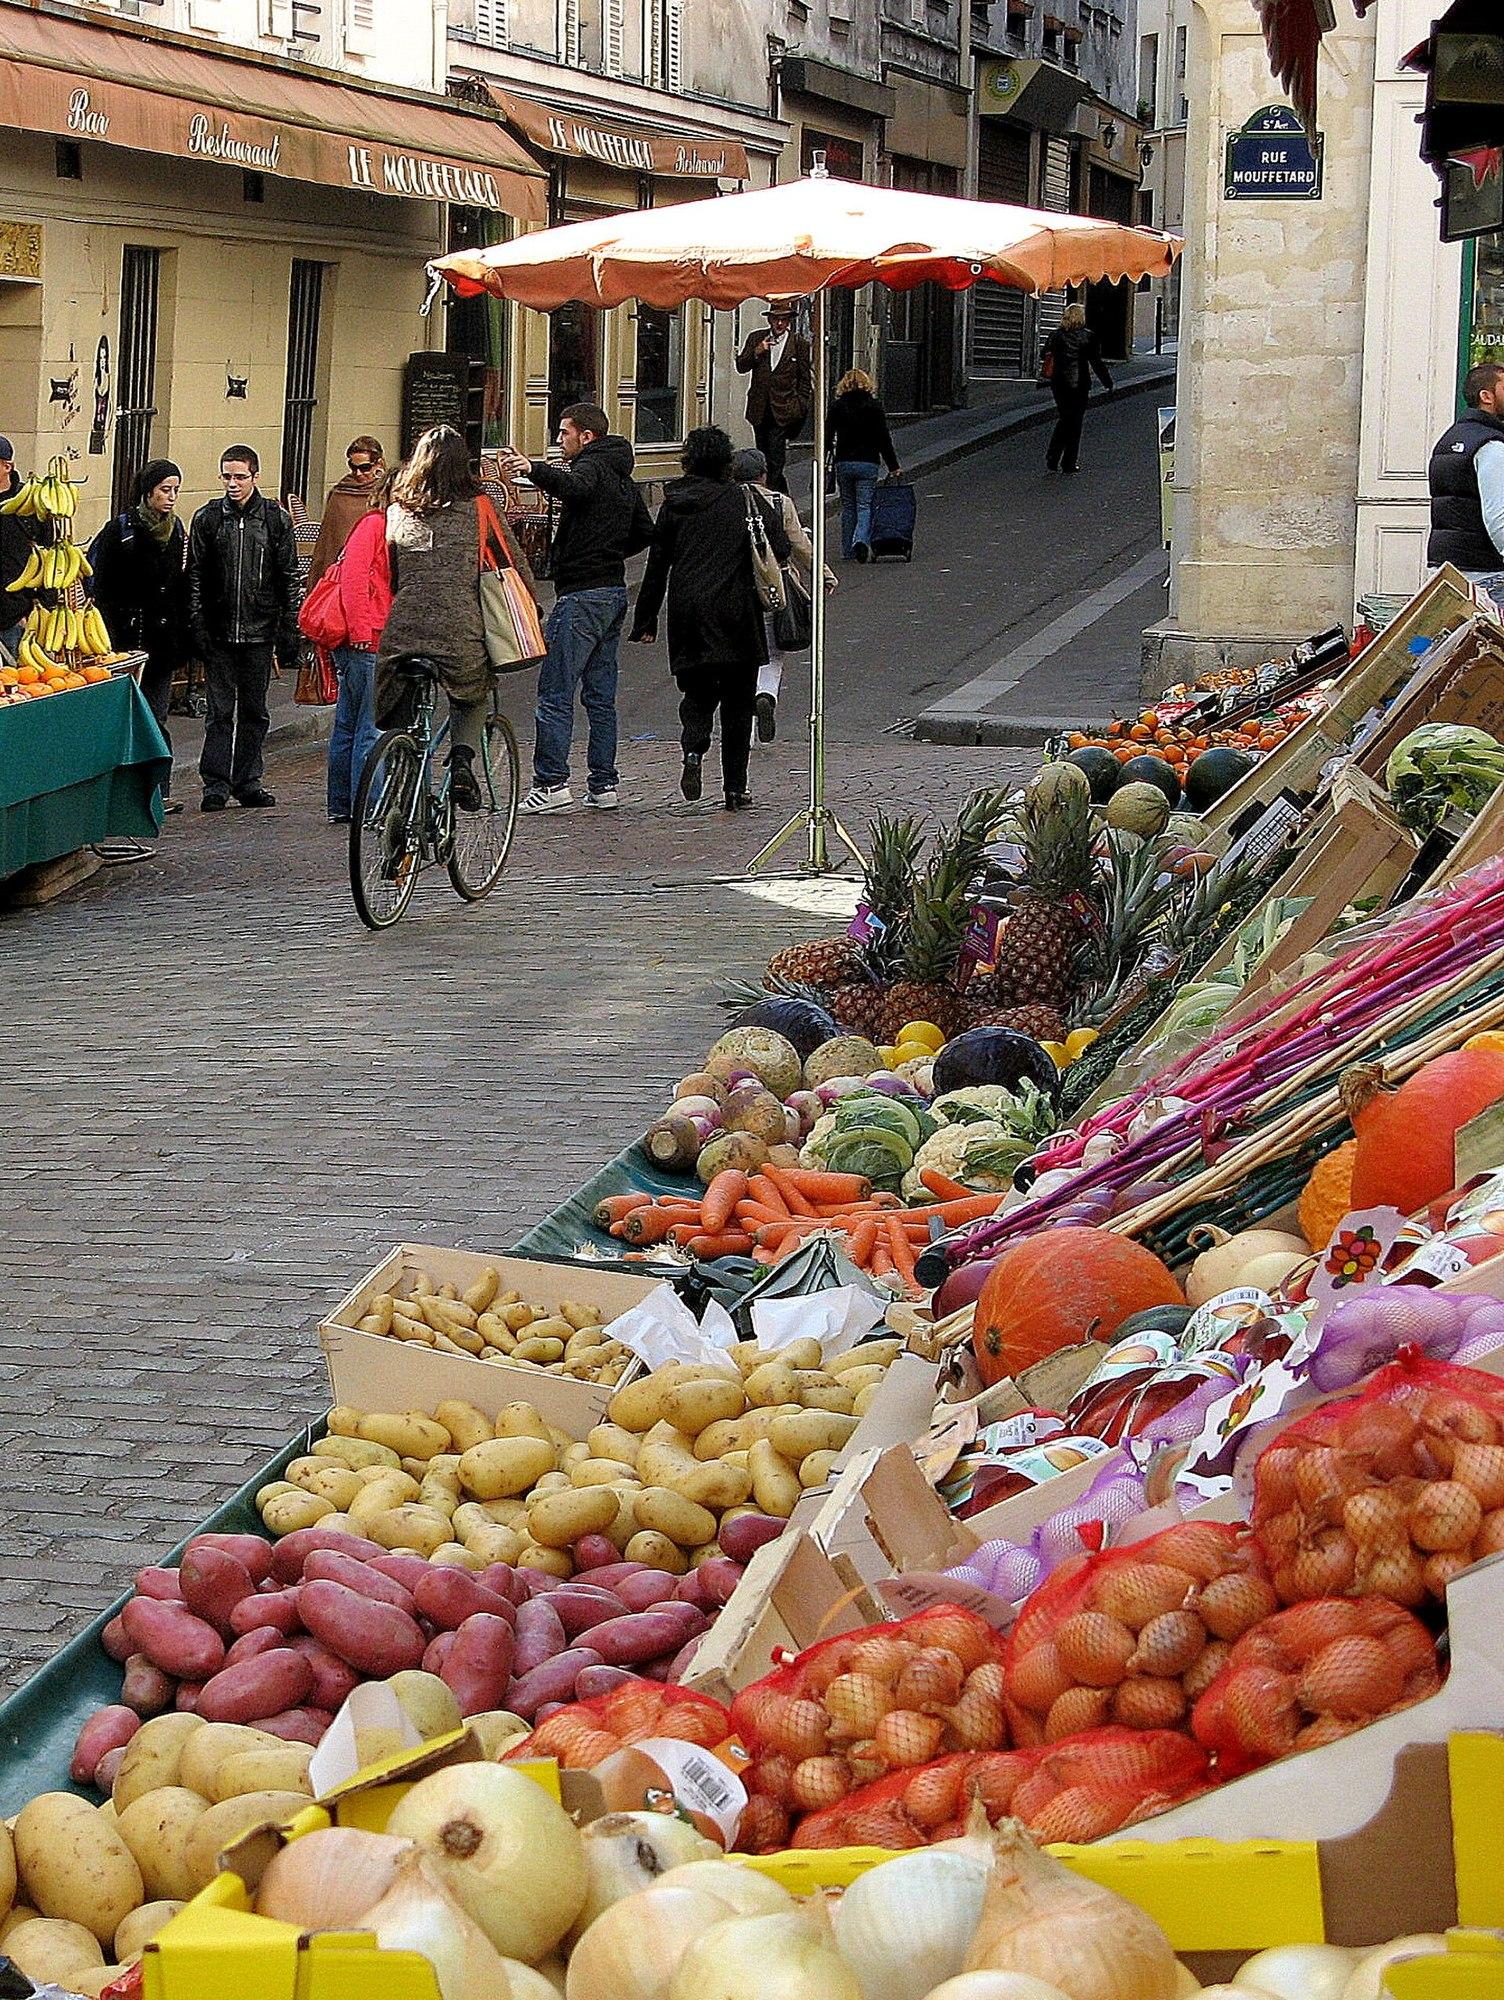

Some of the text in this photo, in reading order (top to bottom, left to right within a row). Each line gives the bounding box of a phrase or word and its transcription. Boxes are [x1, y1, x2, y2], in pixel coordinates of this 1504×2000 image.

[67, 88, 109, 135] Bar
[188, 113, 280, 169] Restaurant
[348, 145, 376, 188] LE
[549, 117, 571, 151] LE
[675, 146, 726, 174] Restaurant
[1261, 151, 1288, 164] RUE
[1233, 171, 1314, 183] MOUFFETARD
